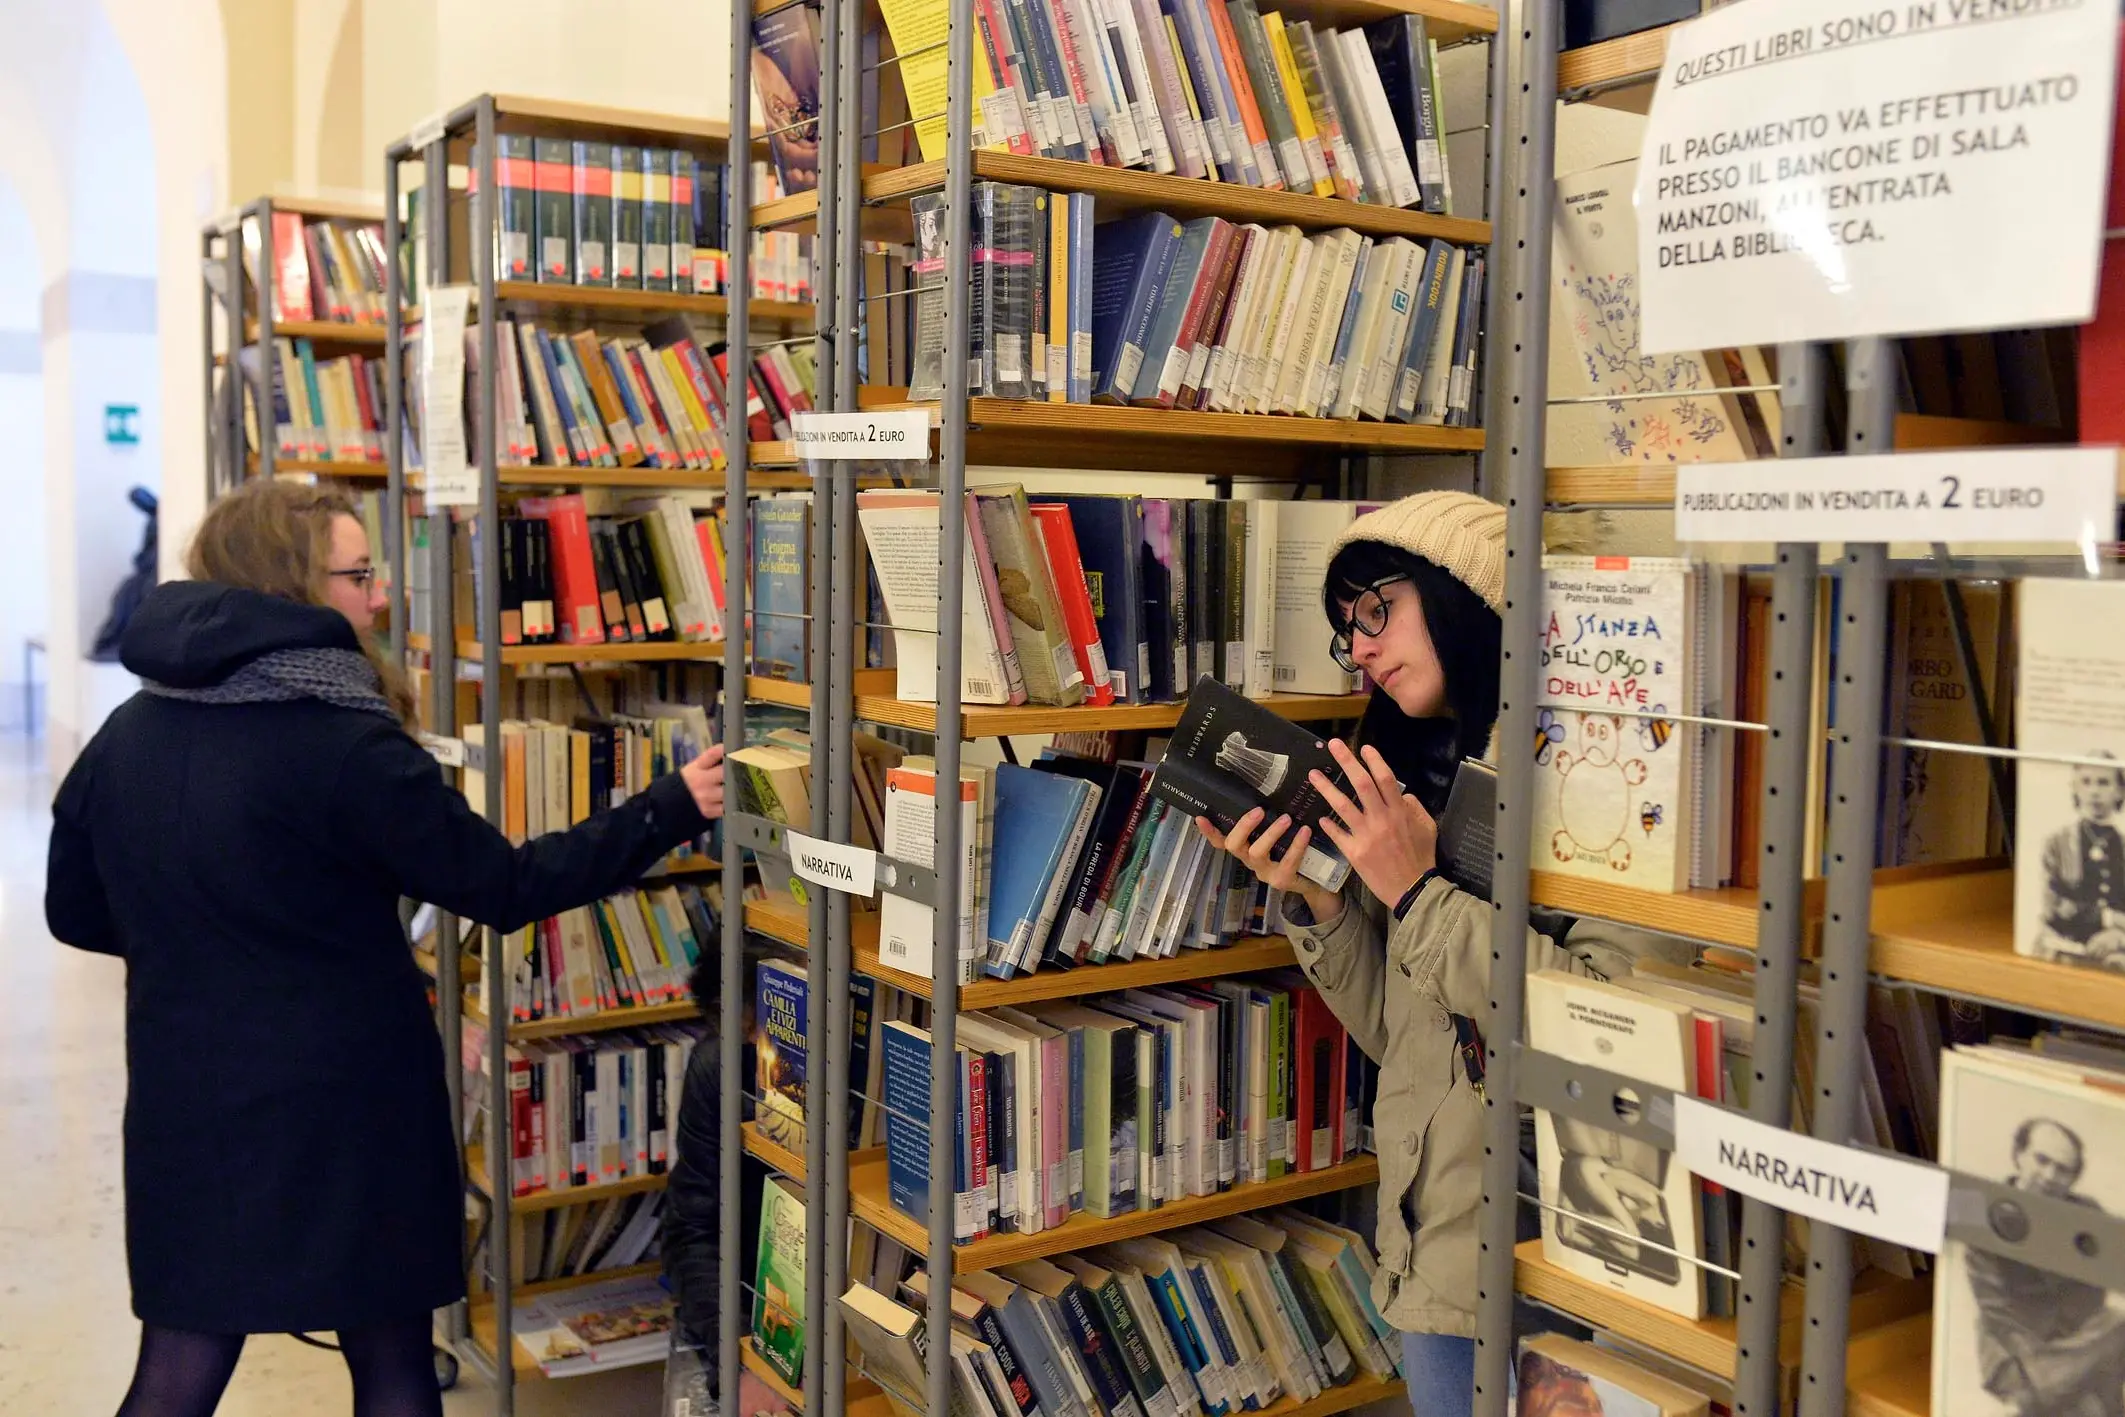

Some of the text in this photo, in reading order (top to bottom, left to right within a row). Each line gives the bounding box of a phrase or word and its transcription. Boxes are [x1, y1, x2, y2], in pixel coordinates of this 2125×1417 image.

[1675, 44, 1747, 87] QUESTI
[1754, 26, 1812, 63] LIBRI
[1821, 9, 1896, 47] SONO
[1907, 3, 1936, 29] IN
[1420, 92, 1433, 137] Borgia
[1659, 73, 2079, 166] IL PAGAMENTO VA EFFETTUATO
[1657, 123, 2030, 200] PRESSO IL BANCONE DI SALA
[1657, 199, 1767, 235] MANZONI,
[1658, 217, 1885, 269] DELLA BIBLIECA.
[1428, 250, 1448, 309] ROBIN COOK
[1143, 283, 1159, 314] L'OSPITE
[1310, 279, 1328, 315] DELTA
[1306, 316, 1319, 330] DI
[828, 431, 858, 442] VENDITA
[860, 432, 865, 442] A
[868, 424, 876, 442] 2
[880, 430, 905, 442] EURO
[1683, 474, 2045, 512] PUBBLICAZIONI IN VENDITA A 2 EURO
[763, 538, 797, 563] L'enigma
[1586, 581, 1618, 593] Franco
[1572, 612, 1662, 645] STANZA
[1541, 644, 1664, 679] DELL'ORSO E
[1547, 676, 1650, 706] DELL'APE
[1190, 704, 1219, 746] EDWARDS
[1159, 779, 1194, 804] EDWARDS
[1192, 798, 1208, 811] KIM
[1095, 842, 1103, 852] LA
[801, 853, 853, 882] NARRATIVA
[1087, 852, 1101, 877] PREDA
[763, 988, 796, 1017] CAMILLA
[766, 1017, 806, 1050] APPARENTI
[781, 1011, 796, 1031] VIZI
[970, 1088, 984, 1126] Jane Green
[1718, 1139, 1879, 1216] NARRATIVA
[983, 1316, 1016, 1376] ROBIN COOK
